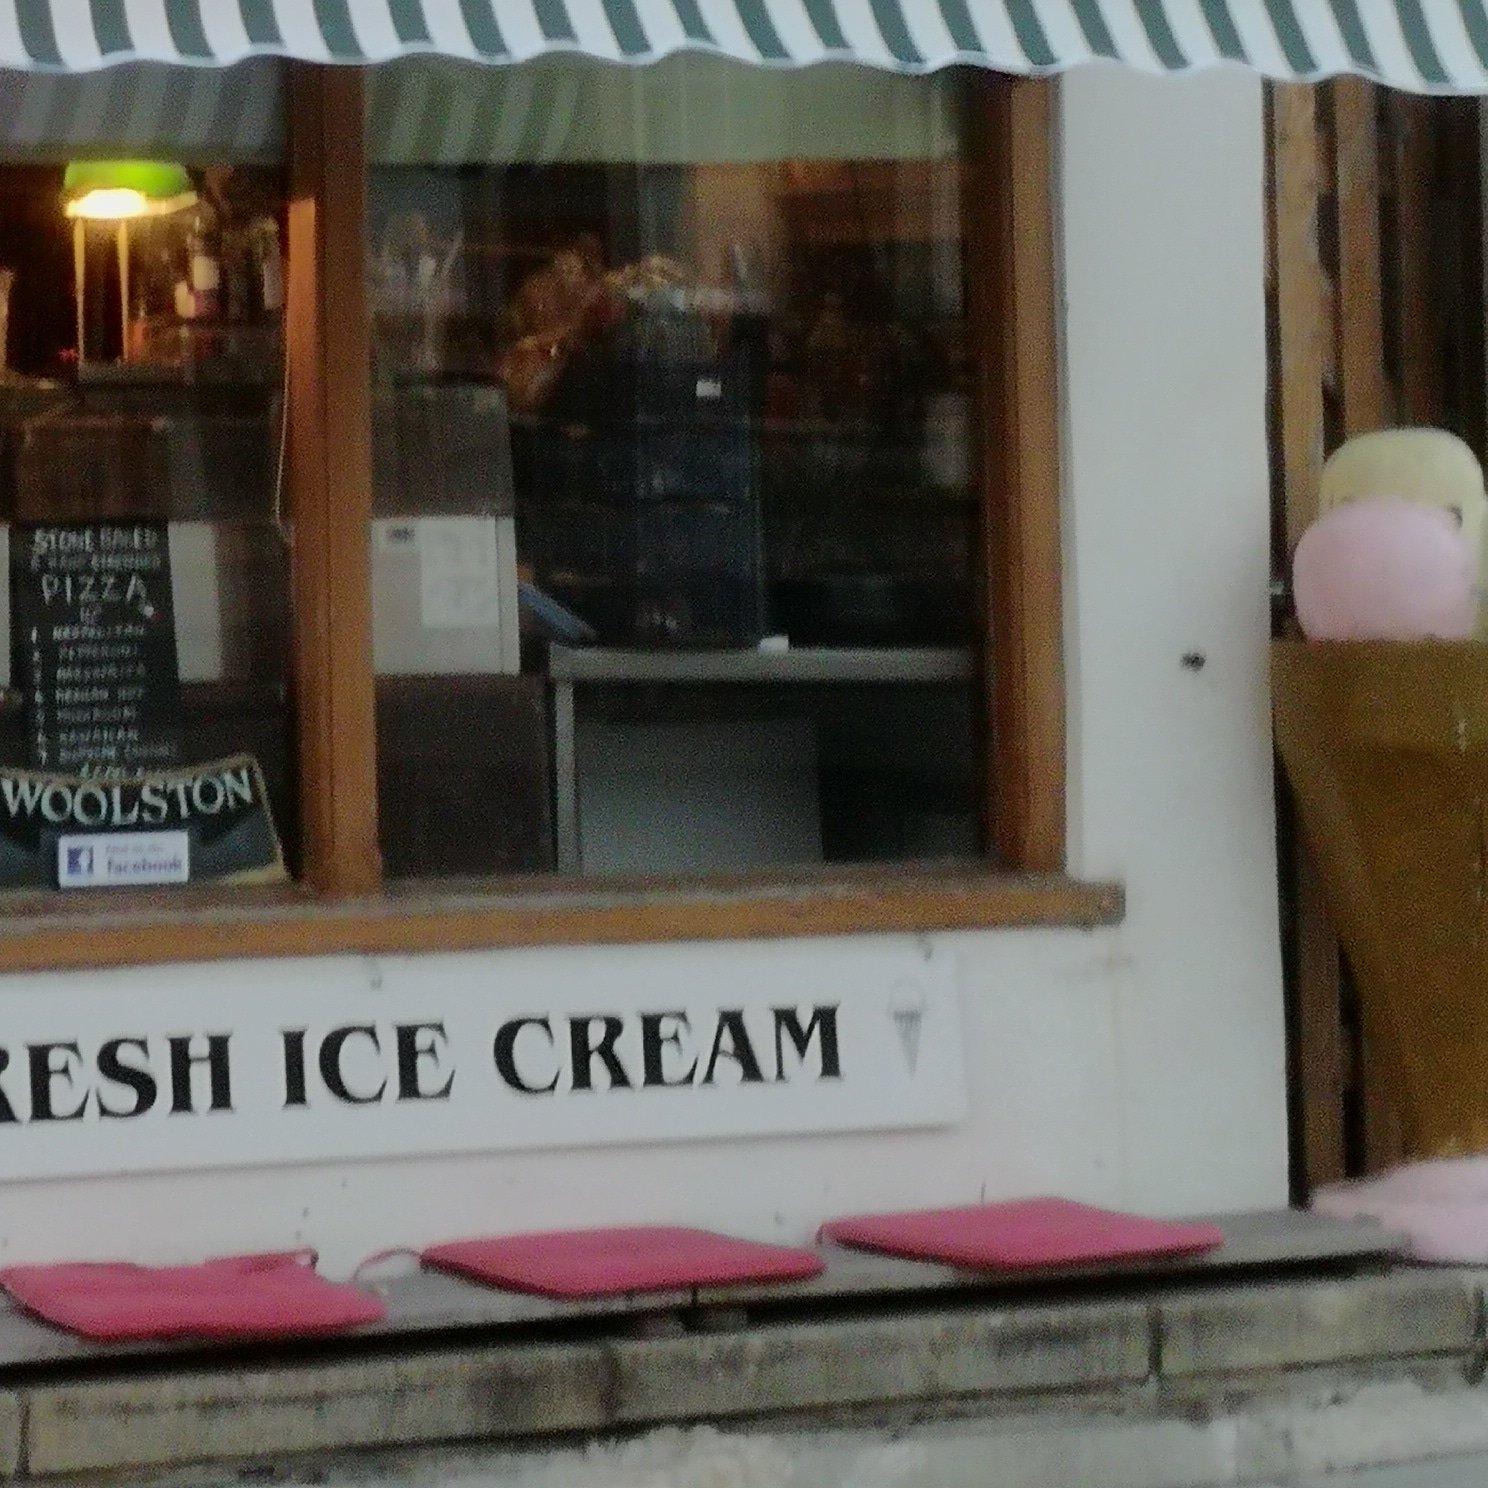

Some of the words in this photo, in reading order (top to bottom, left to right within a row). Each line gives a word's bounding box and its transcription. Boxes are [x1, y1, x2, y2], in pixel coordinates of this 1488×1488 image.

[42, 572, 149, 606] PIZZA
[0, 768, 254, 825] WOOLSTON
[280, 1021, 455, 1108] ICE
[492, 1003, 843, 1098] CREAM
